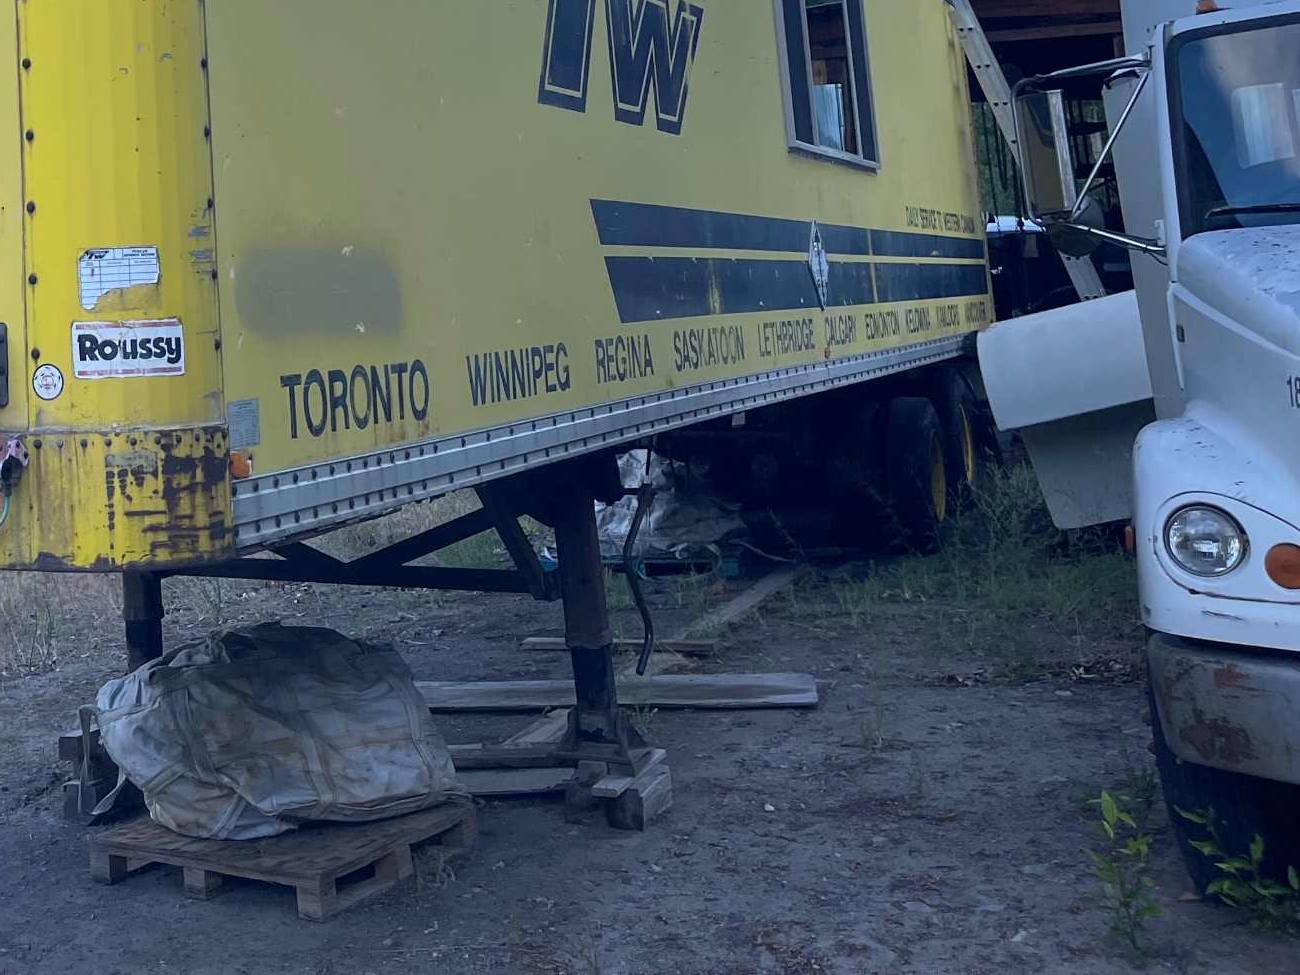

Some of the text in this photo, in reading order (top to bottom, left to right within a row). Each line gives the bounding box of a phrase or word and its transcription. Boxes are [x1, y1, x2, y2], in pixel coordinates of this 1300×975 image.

[77, 334, 182, 364] Roussy
[279, 359, 430, 439] TORONTO
[466, 342, 571, 406] WINNIPEG
[594, 334, 655, 384] REGINA
[673, 326, 745, 372] SASKATOON
[757, 318, 816, 357] LETHBRIDGE
[824, 314, 857, 346] CALGARY
[864, 310, 900, 341] EDMONTON
